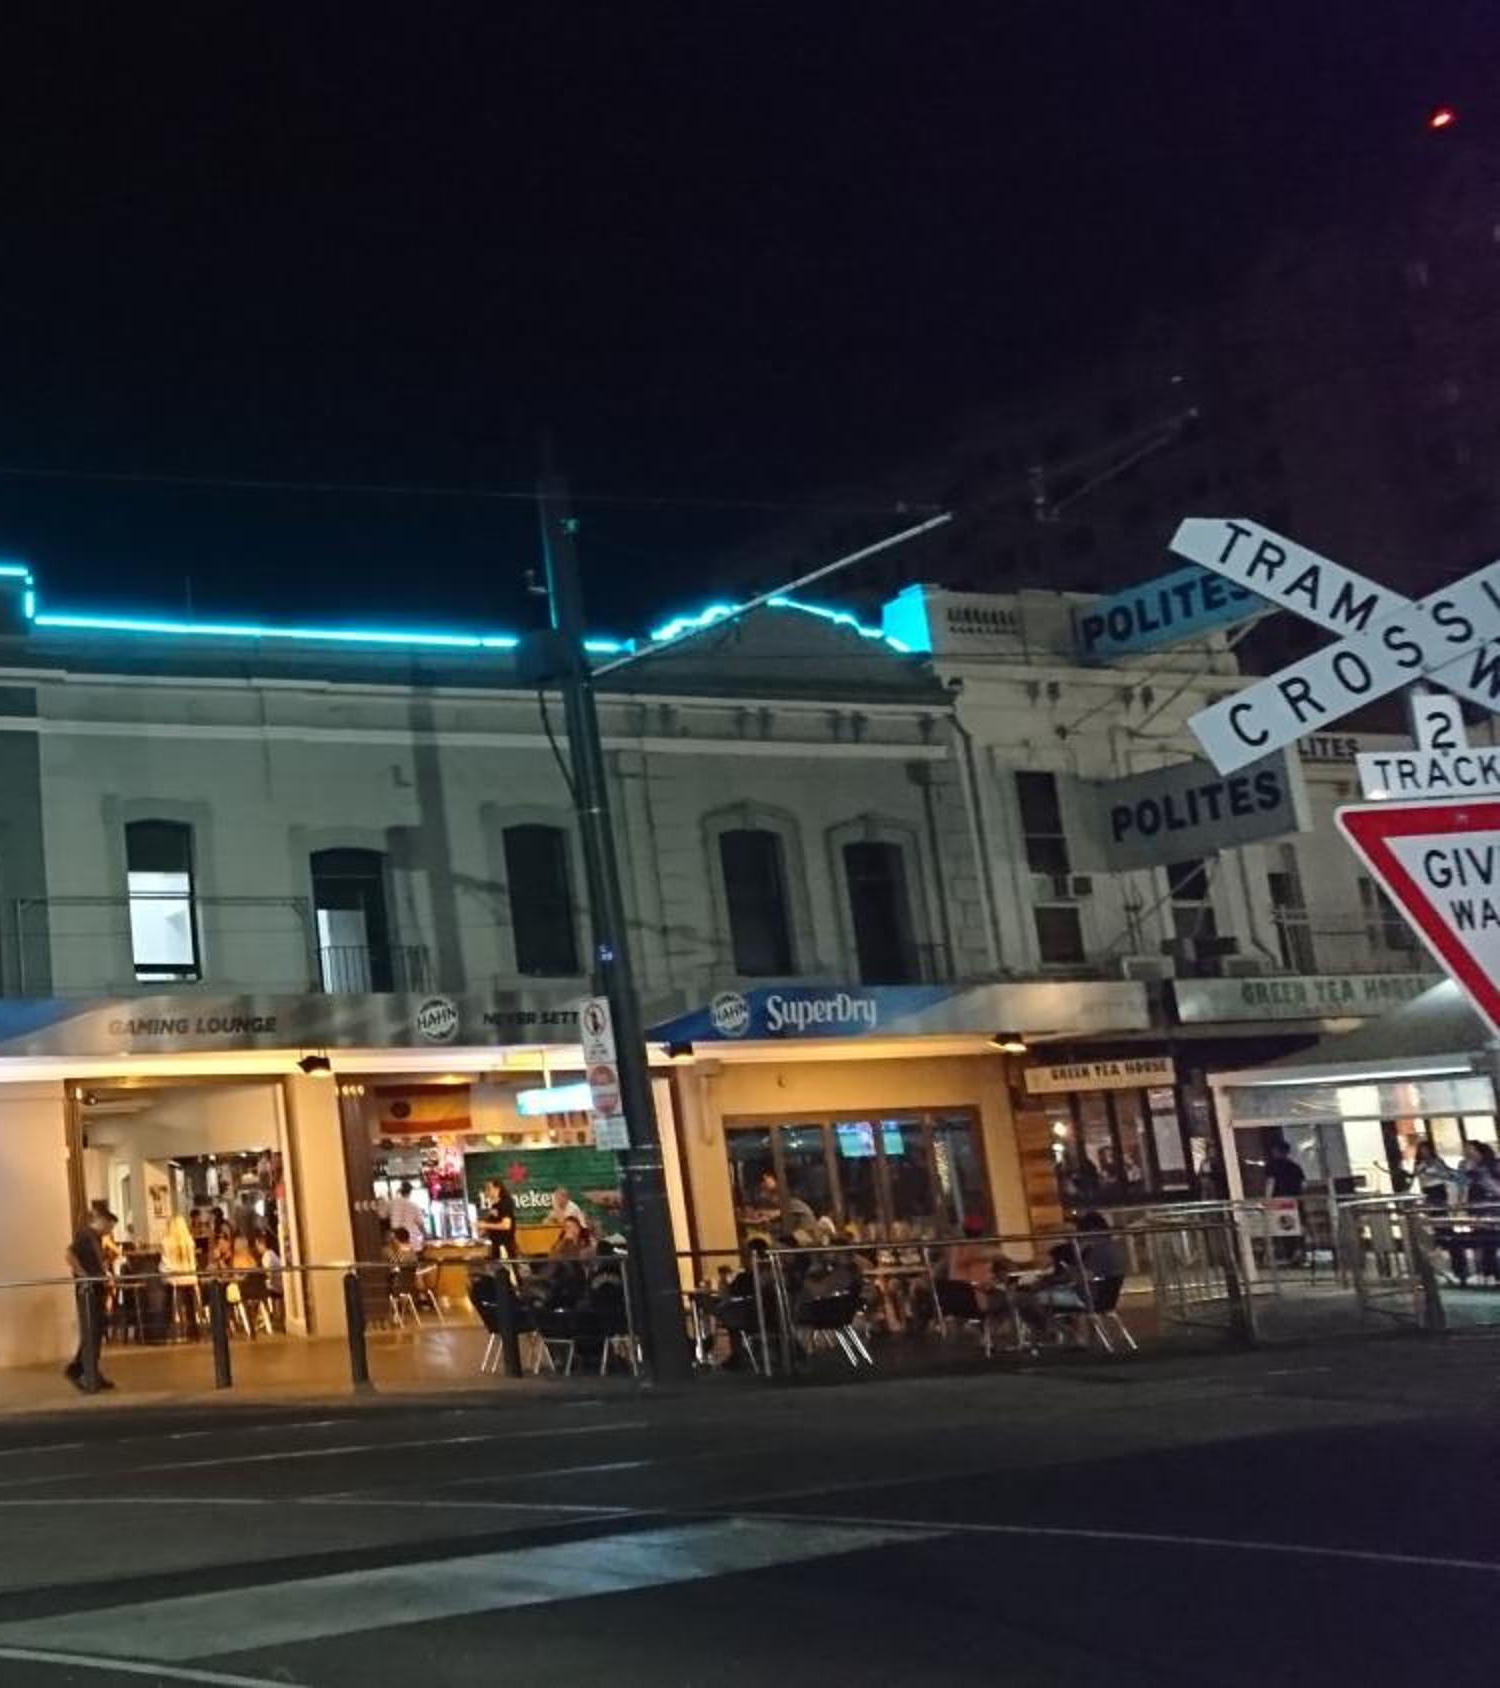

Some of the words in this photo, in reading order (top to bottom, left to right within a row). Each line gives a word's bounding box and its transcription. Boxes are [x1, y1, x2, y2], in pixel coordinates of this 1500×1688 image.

[1214, 522, 1379, 632] TRAM
[1427, 712, 1456, 749] 2
[1111, 770, 1282, 842] POLITES
[108, 1018, 190, 1035] GAMING
[195, 1016, 277, 1034] LOUNGE
[417, 1006, 456, 1030] HAHN
[766, 993, 876, 1032] SuperDry
